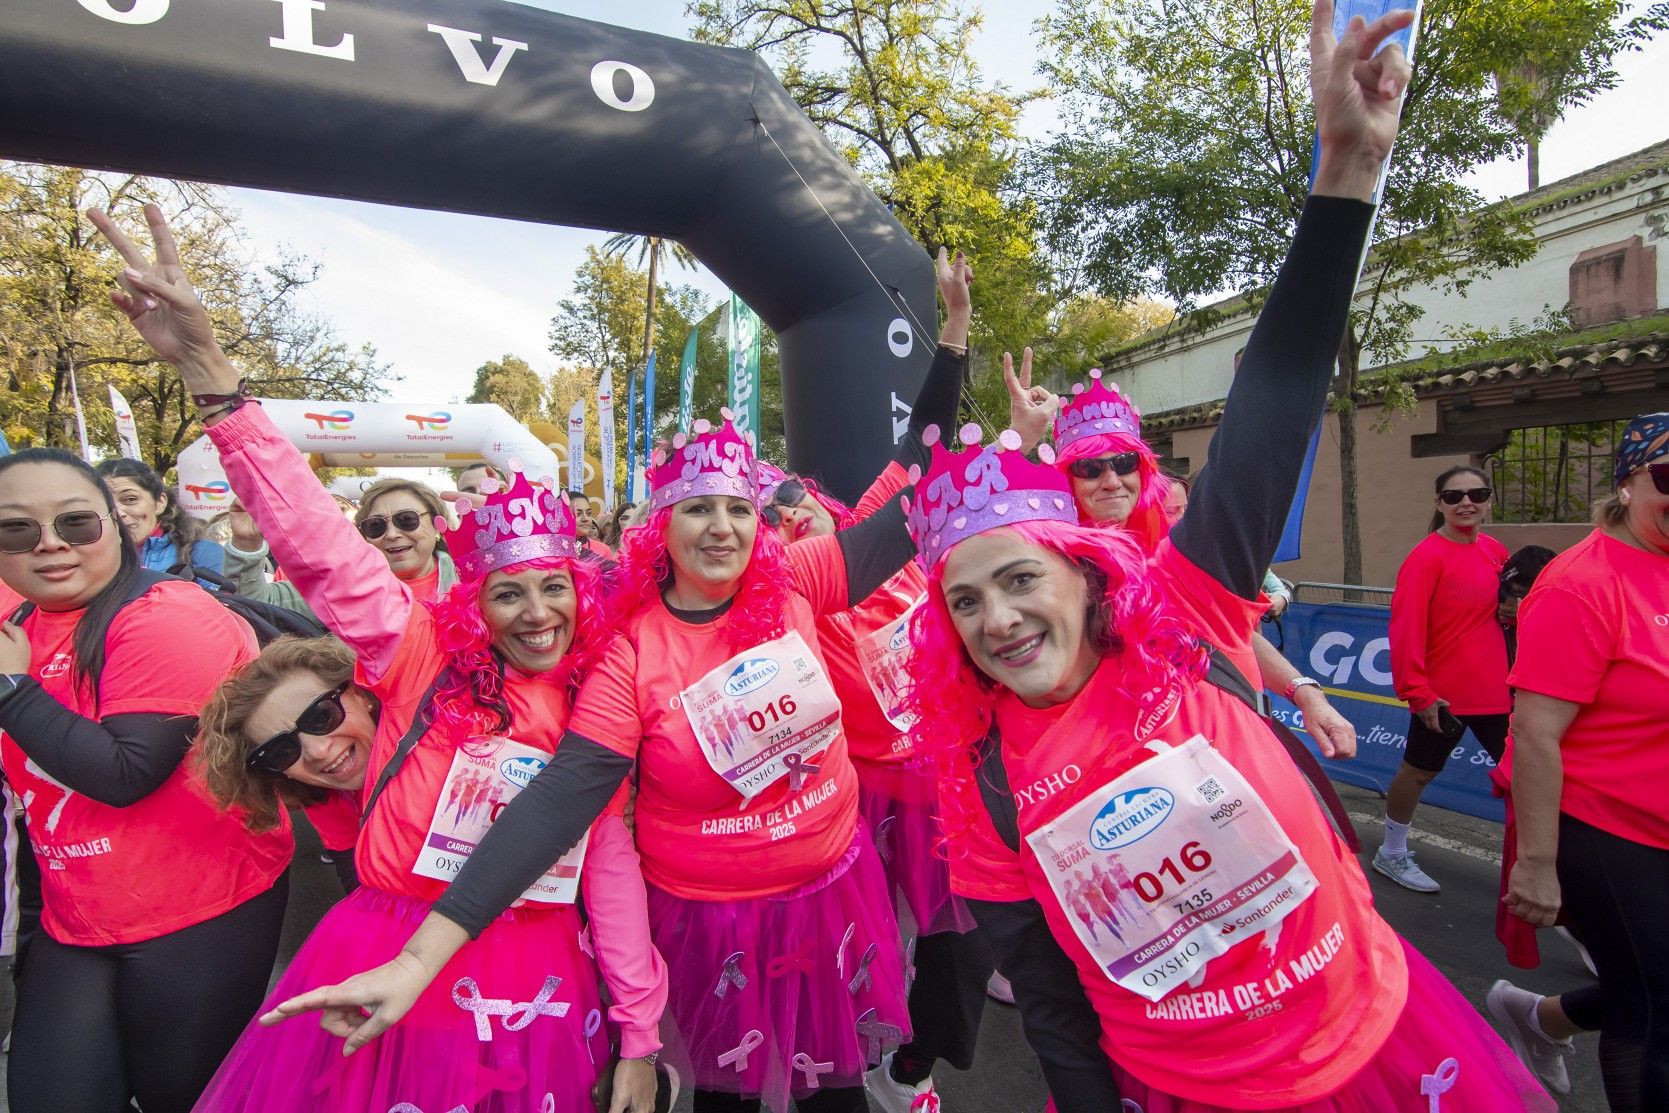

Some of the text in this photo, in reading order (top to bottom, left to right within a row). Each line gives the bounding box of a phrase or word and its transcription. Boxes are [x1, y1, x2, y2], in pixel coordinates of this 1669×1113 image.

[729, 664, 777, 694] ASTURIANA
[697, 692, 723, 713] SUMA
[748, 694, 797, 732] 016
[769, 727, 792, 744] 7134
[468, 757, 496, 770] SUMA
[736, 756, 763, 775] CARRERA
[763, 749, 772, 760] DE
[771, 746, 780, 756] LA
[702, 778, 837, 834] CARRERA DE LA MUJER
[770, 821, 796, 841] 2025
[1095, 797, 1170, 847] ASTURIANA
[63, 837, 112, 858] MUJER
[447, 841, 473, 854] CARRER
[1051, 839, 1084, 862] TU DORSAL
[1057, 848, 1091, 872] SUMA
[435, 857, 460, 873] OYS
[1133, 841, 1212, 902] 016
[529, 883, 559, 893] ander
[1173, 888, 1213, 915] 7135
[1236, 886, 1293, 929] Santander
[1134, 936, 1175, 963] CARRERA
[1174, 923, 1187, 938] DE
[1186, 916, 1200, 929] LA
[1199, 900, 1233, 921] MUJER
[1237, 871, 1275, 901] SEVILLA
[1142, 941, 1200, 987] OYSHO
[1145, 922, 1345, 1021] CARRERA DE LA MUJER
[1246, 1000, 1283, 1021] 2025
